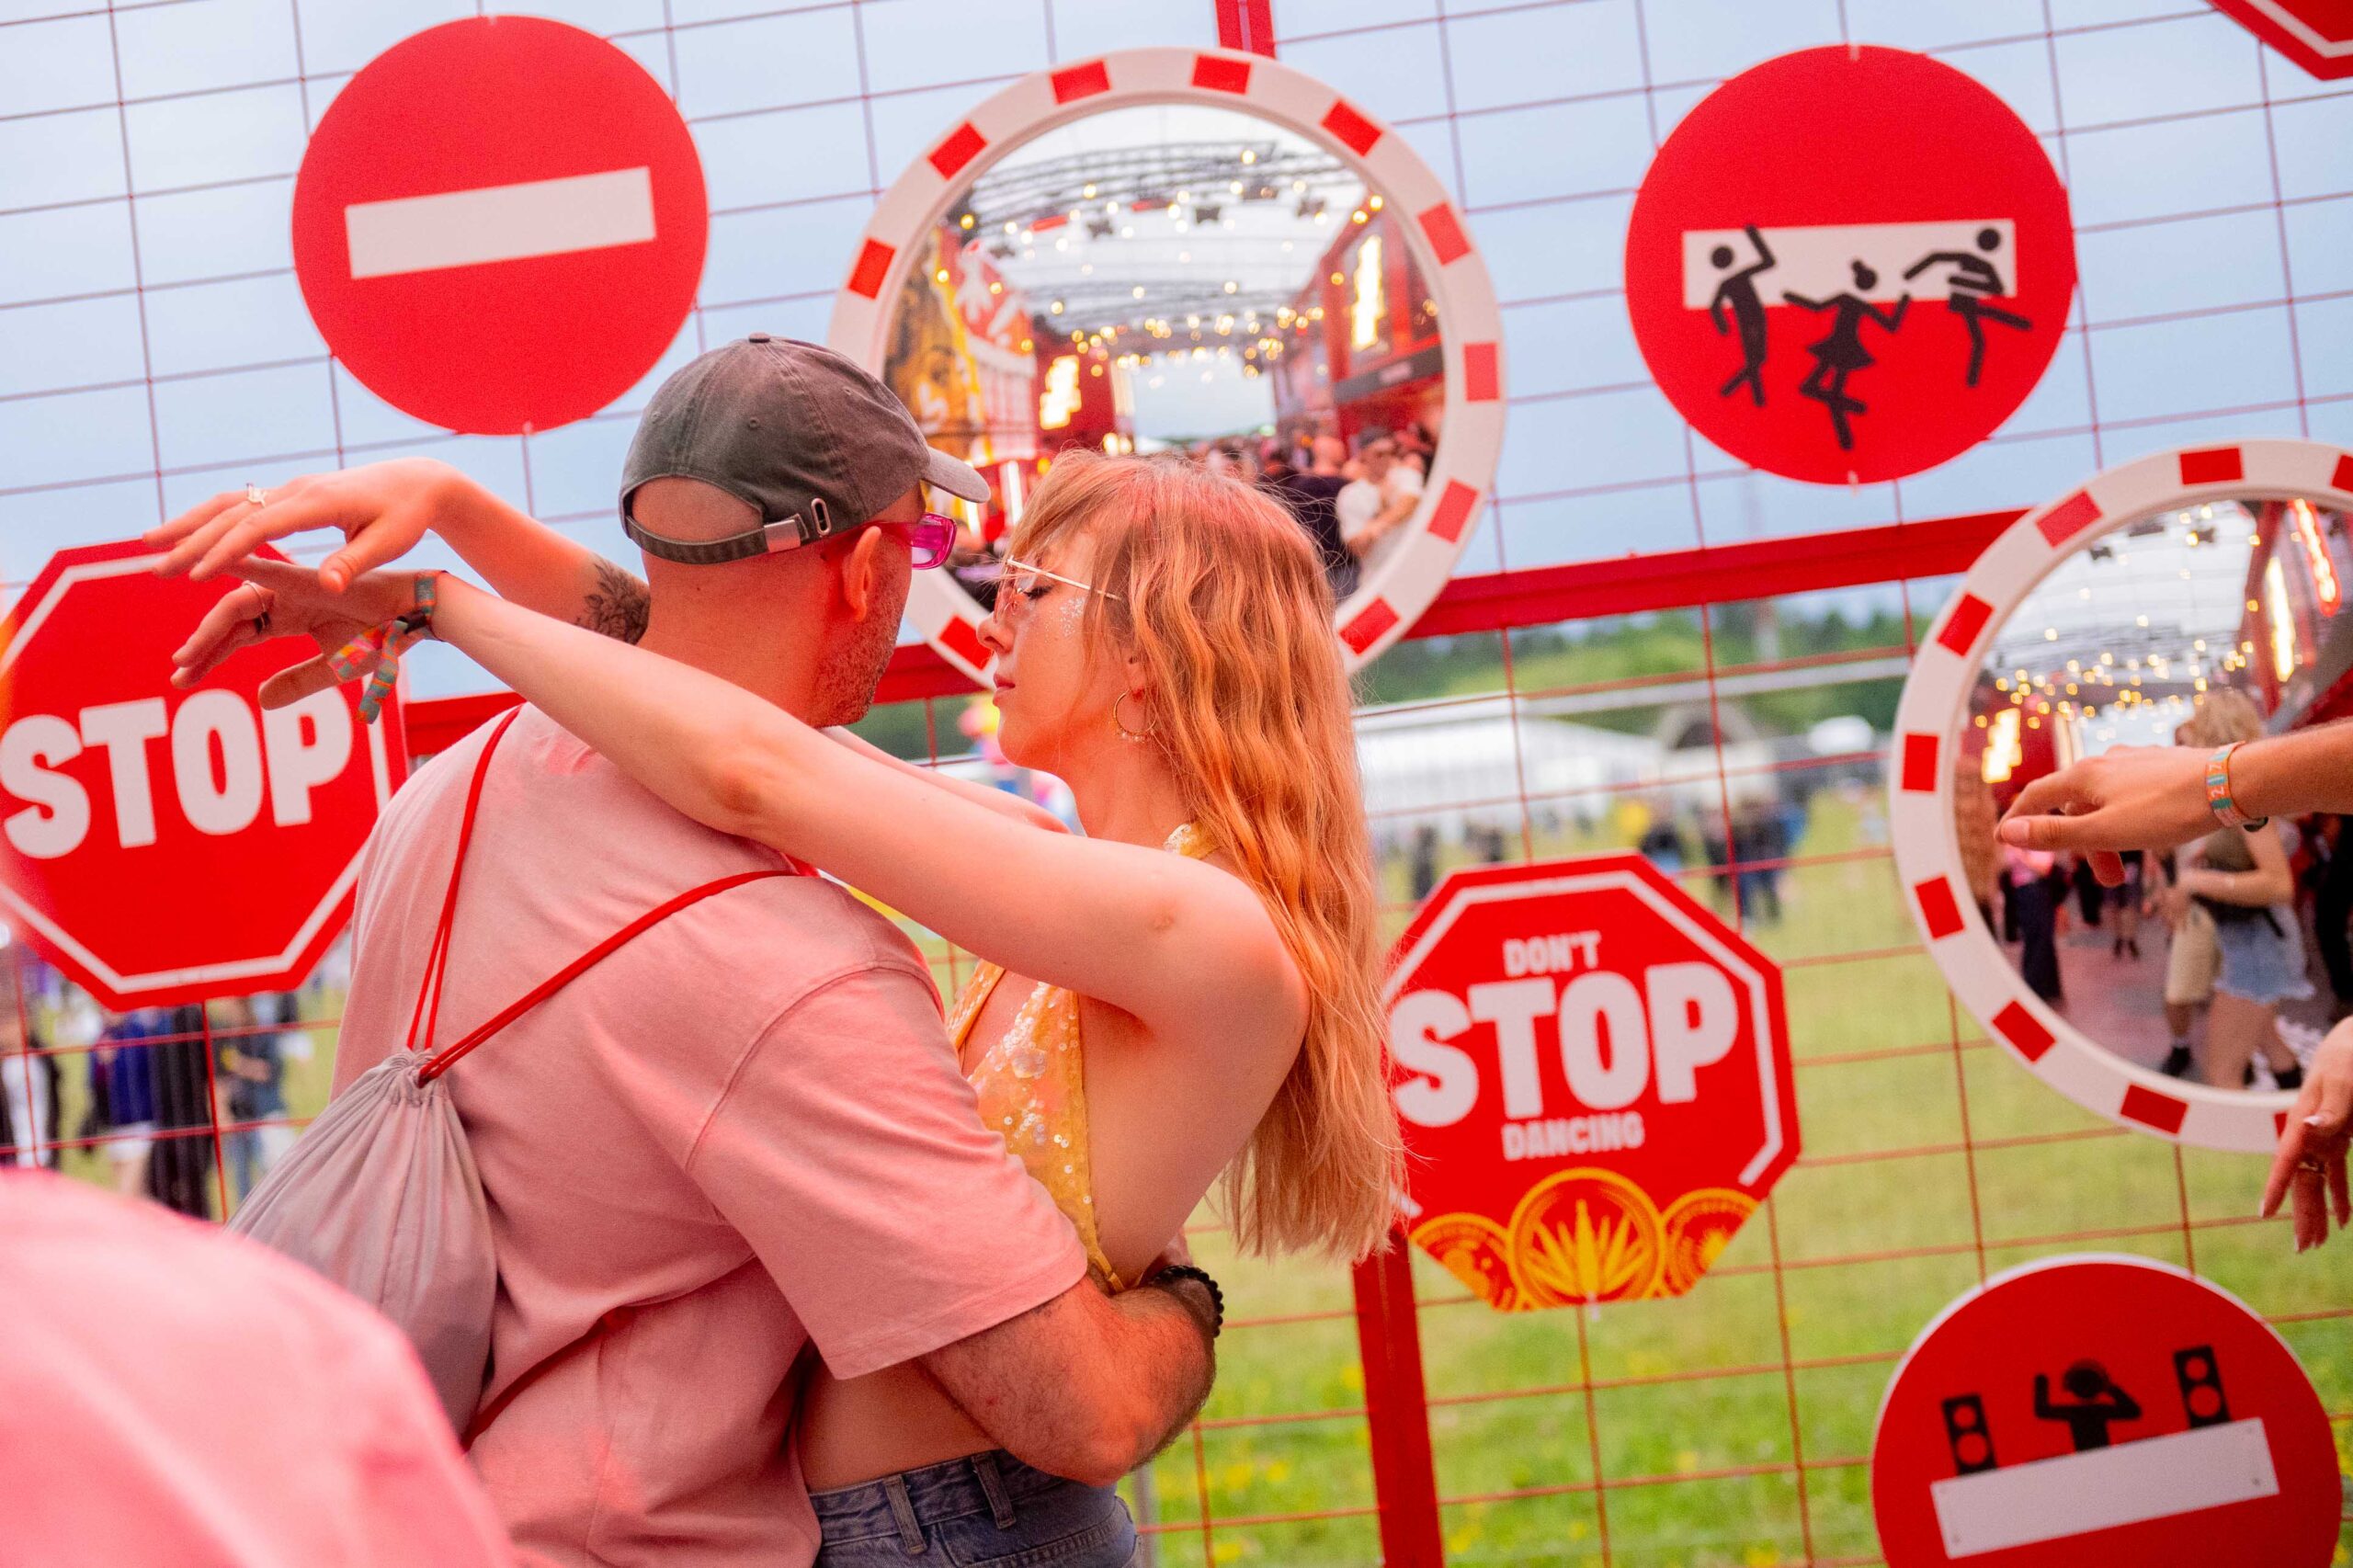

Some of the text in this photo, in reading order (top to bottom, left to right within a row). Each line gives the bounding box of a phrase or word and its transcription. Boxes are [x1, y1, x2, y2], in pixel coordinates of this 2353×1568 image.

[0, 682, 353, 859] STOP
[1502, 929, 1601, 976] DON'T
[1390, 960, 1739, 1128] STOP
[1500, 1110, 1645, 1161] DANCING
